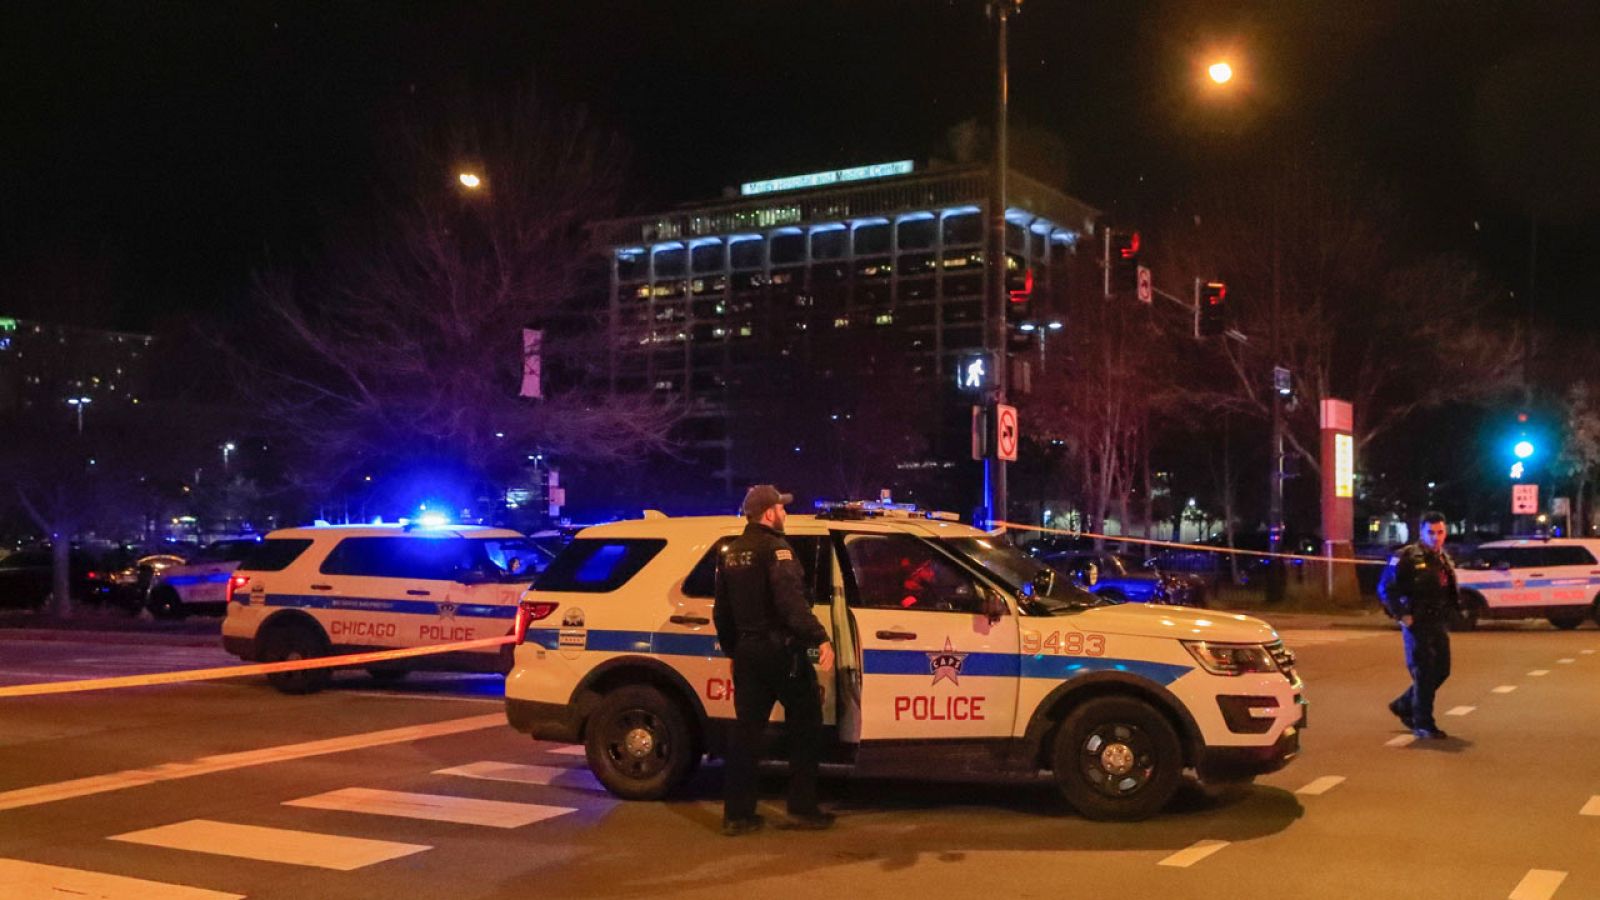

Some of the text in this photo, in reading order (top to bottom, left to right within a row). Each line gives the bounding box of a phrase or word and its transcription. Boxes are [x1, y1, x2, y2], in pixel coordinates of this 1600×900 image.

[330, 620, 475, 641] CHICAGO POLICE
[1022, 630, 1106, 657] 9483
[894, 695, 986, 721] POLICE
